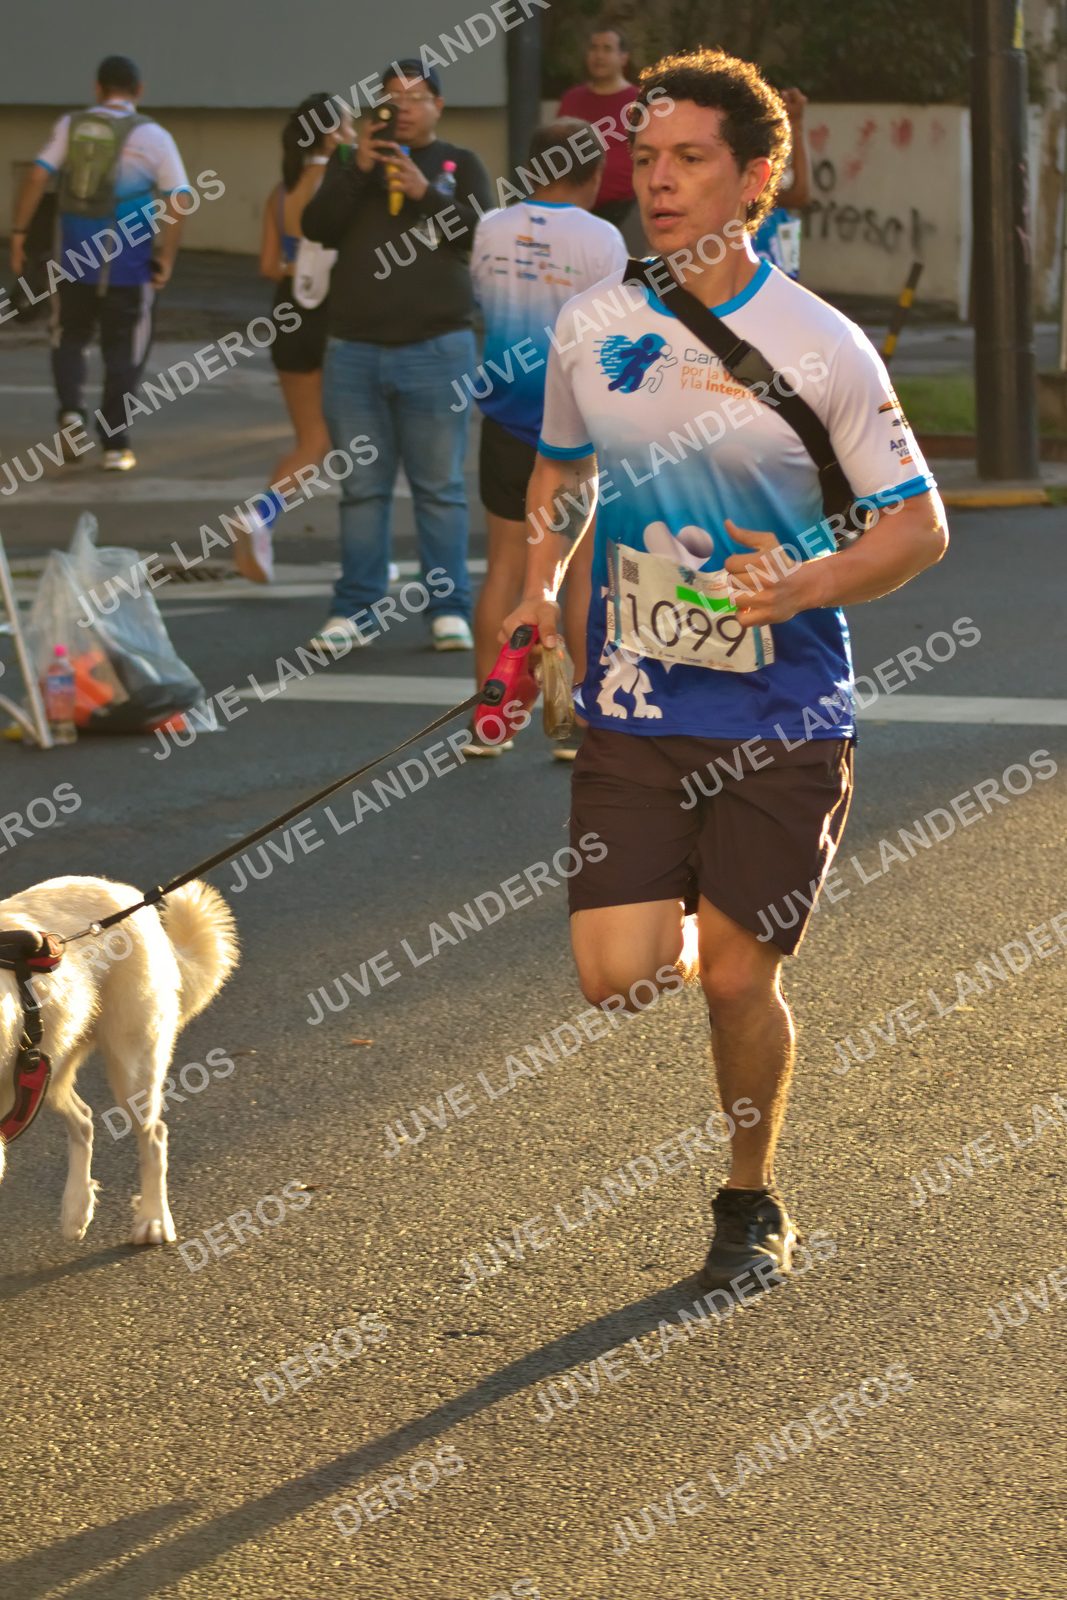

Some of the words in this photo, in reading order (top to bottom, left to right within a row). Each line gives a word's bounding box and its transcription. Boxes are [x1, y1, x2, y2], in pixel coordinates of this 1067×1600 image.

[681, 366, 703, 377] por
[707, 367, 719, 380] la
[680, 378, 688, 390] y
[691, 377, 702, 390] la
[626, 593, 747, 658] 1099
